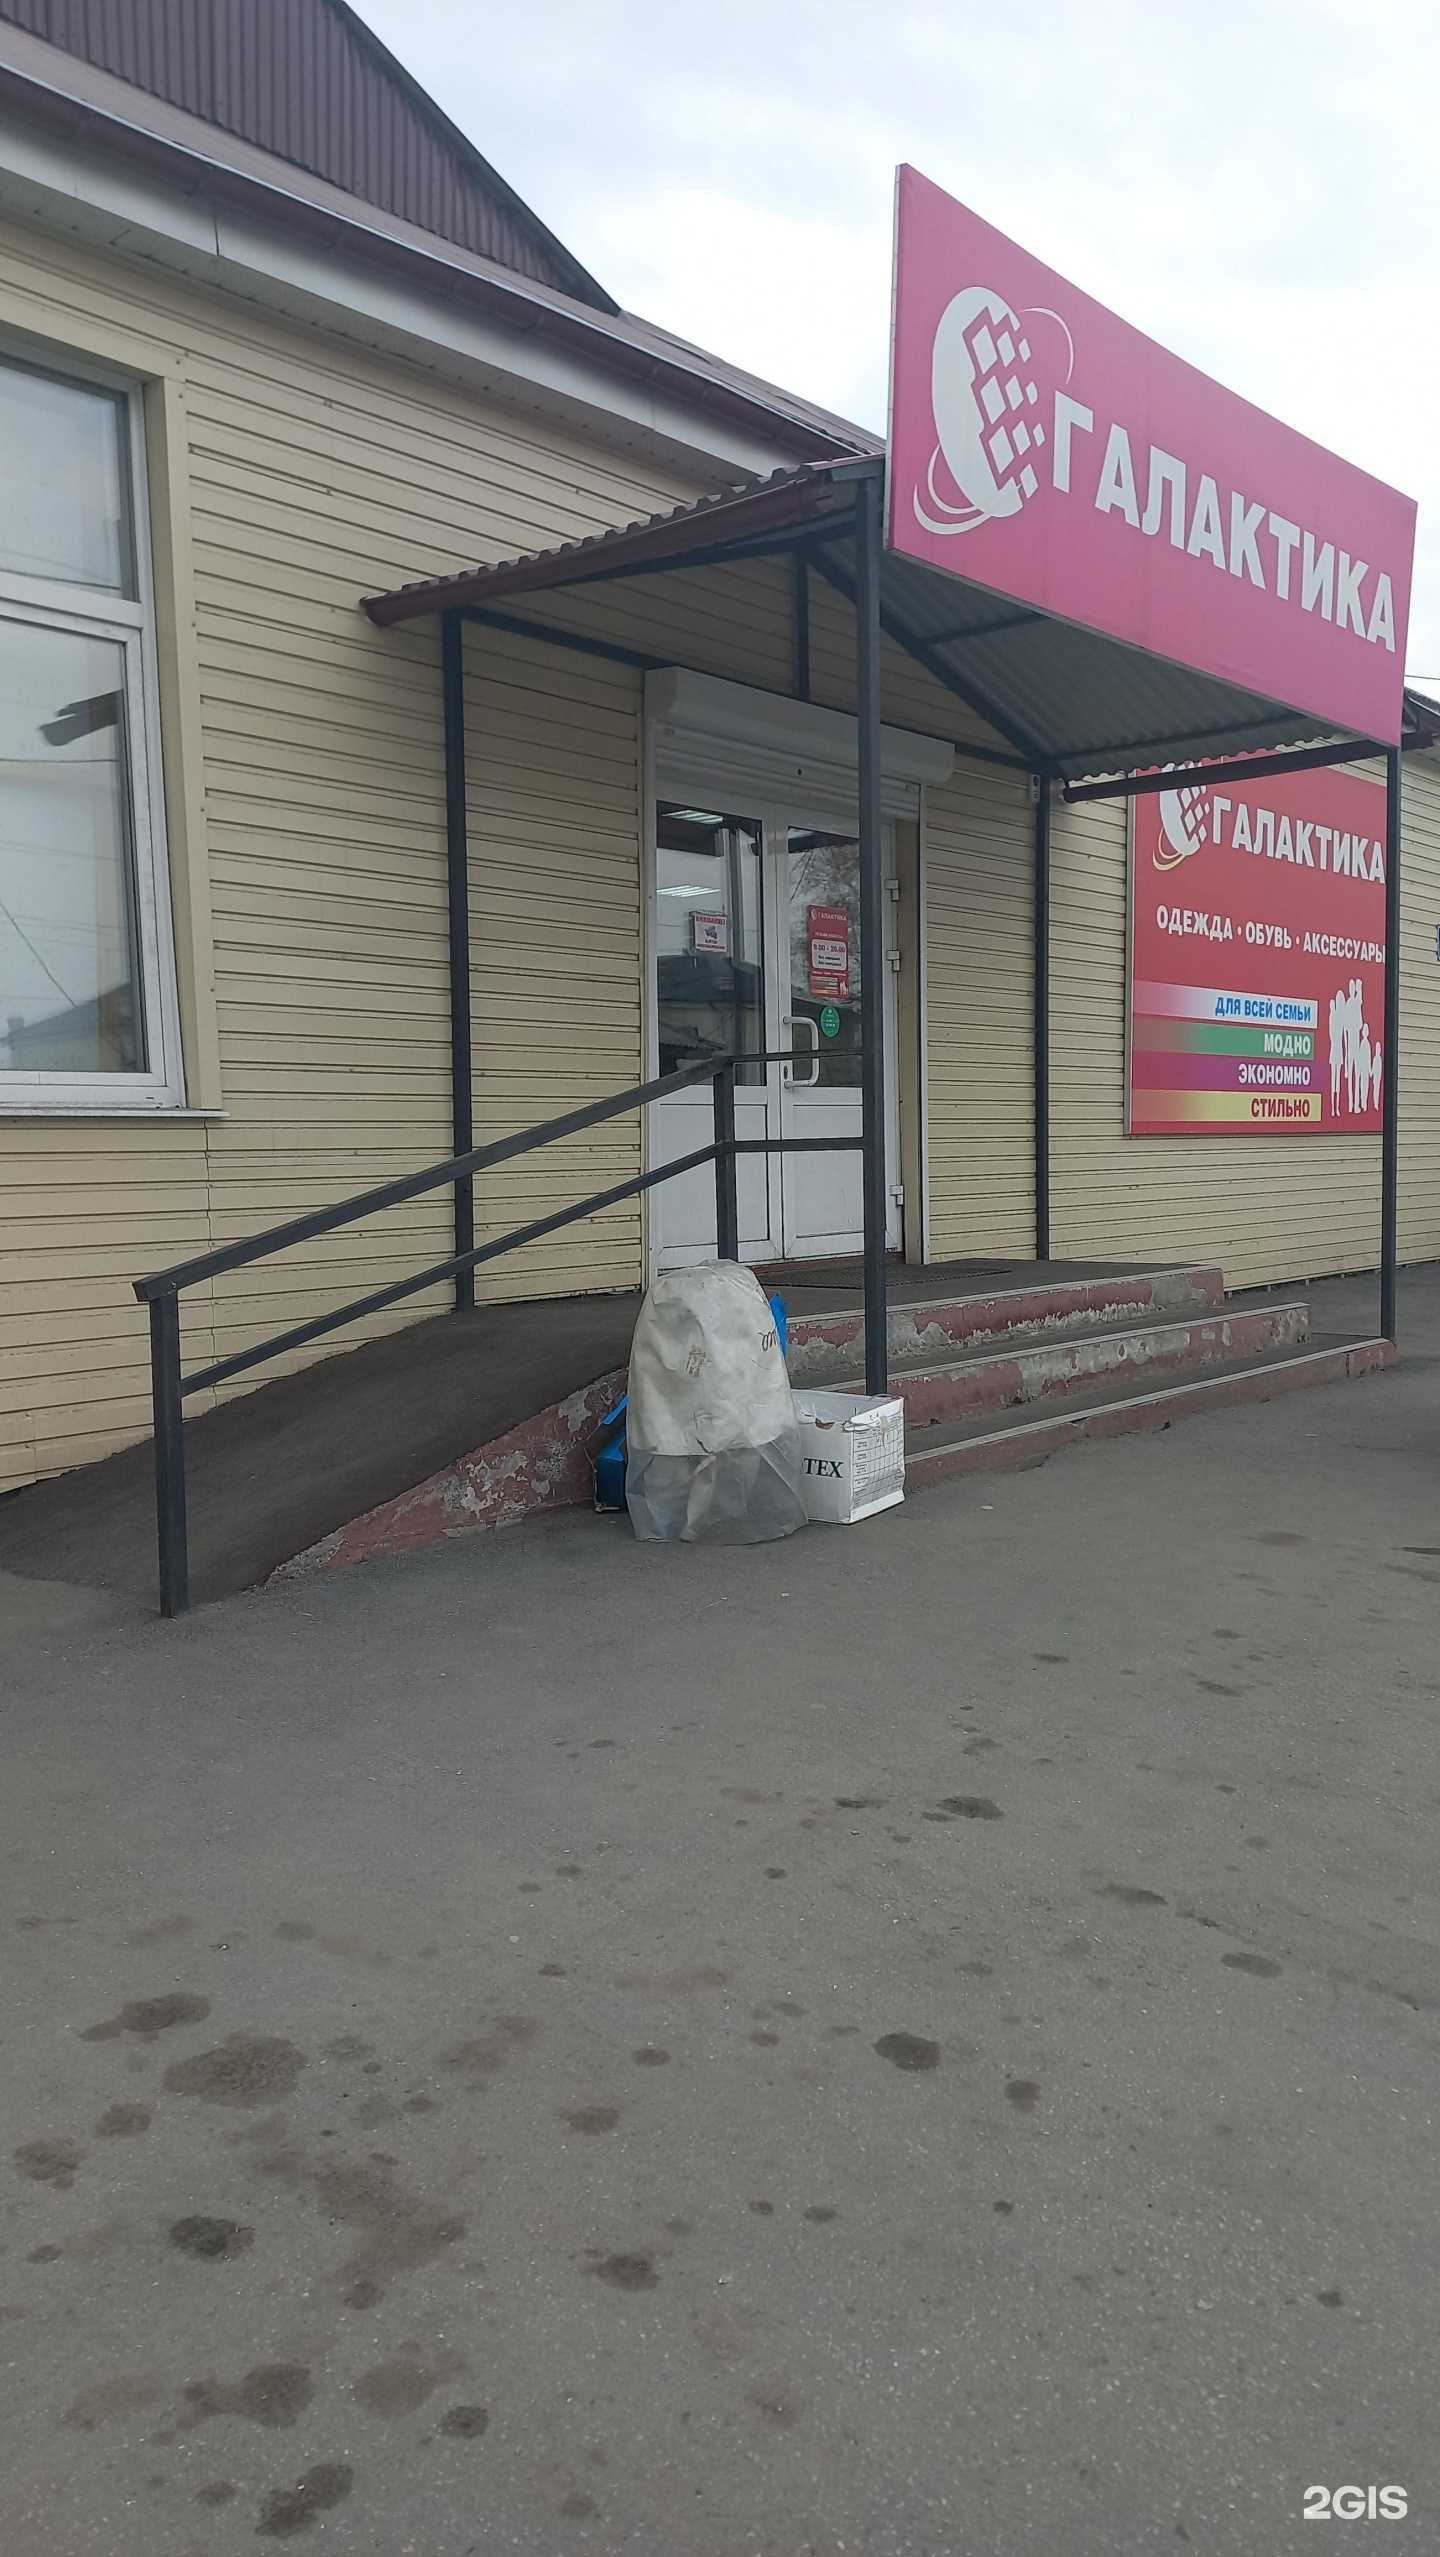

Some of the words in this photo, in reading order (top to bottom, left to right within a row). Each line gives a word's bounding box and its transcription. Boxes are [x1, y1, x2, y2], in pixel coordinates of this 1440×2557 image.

[1053, 390, 1396, 654] ГАЛАКТИКА
[1213, 795, 1386, 884] ГАЛАКТИКА
[1156, 904, 1233, 942] ОДЕЖДА
[1245, 920, 1293, 949] ОБУВЬ
[1303, 931, 1386, 965] АКСЕССУАРЫ
[1215, 997, 1241, 1017] ДЛЯ
[1244, 998, 1273, 1019] ВСЕЙ
[1275, 1003, 1311, 1021] СЕМЬИ
[1263, 1033, 1311, 1057] МОДНО
[1238, 1063, 1311, 1086] ЭКОНОМНО
[1251, 1098, 1311, 1118] СТИЛЬНО
[802, 1457, 844, 1479] TEX
